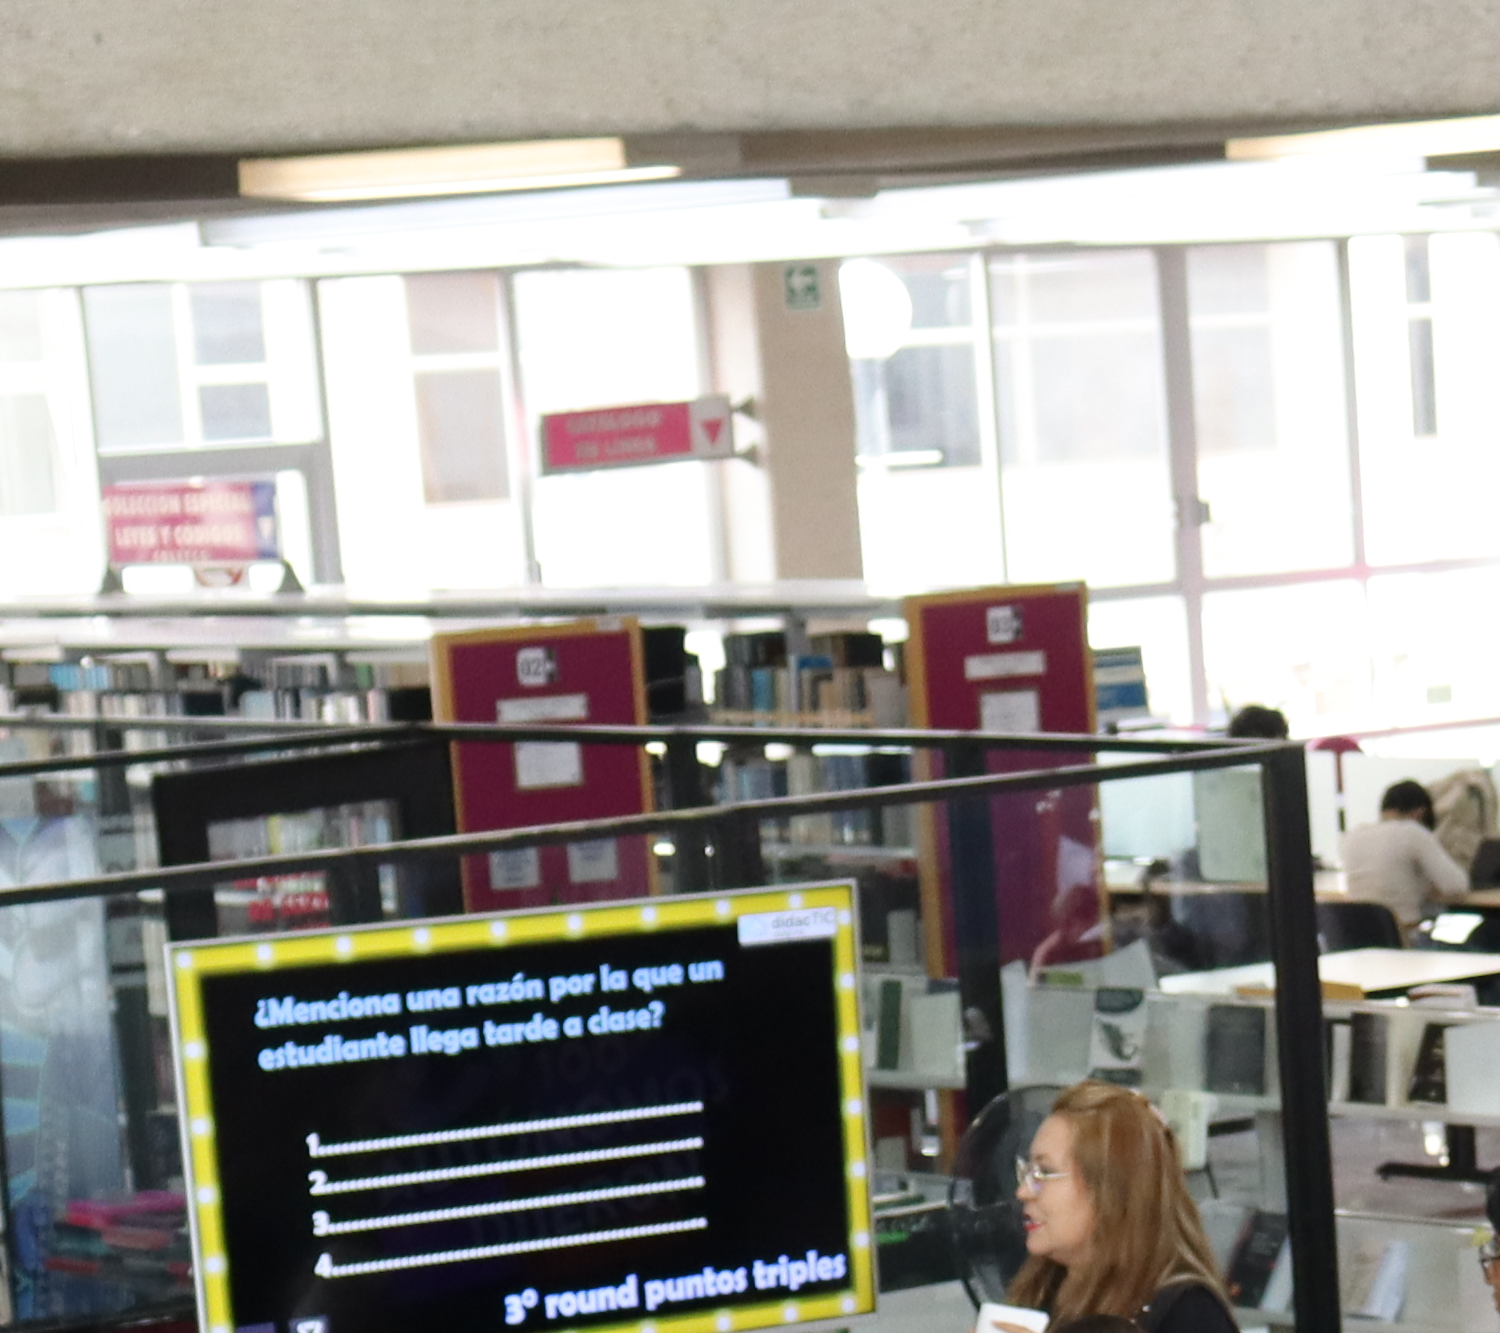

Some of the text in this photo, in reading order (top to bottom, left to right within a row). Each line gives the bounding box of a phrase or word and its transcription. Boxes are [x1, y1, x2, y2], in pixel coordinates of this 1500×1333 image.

[254, 959, 725, 1029] ¿Menciona una razón por la que un
[257, 1000, 667, 1073] estudiante llega tarde a clase?
[544, 1273, 640, 1320] round
[643, 1265, 749, 1312] puntos
[752, 1249, 847, 1292] triples
